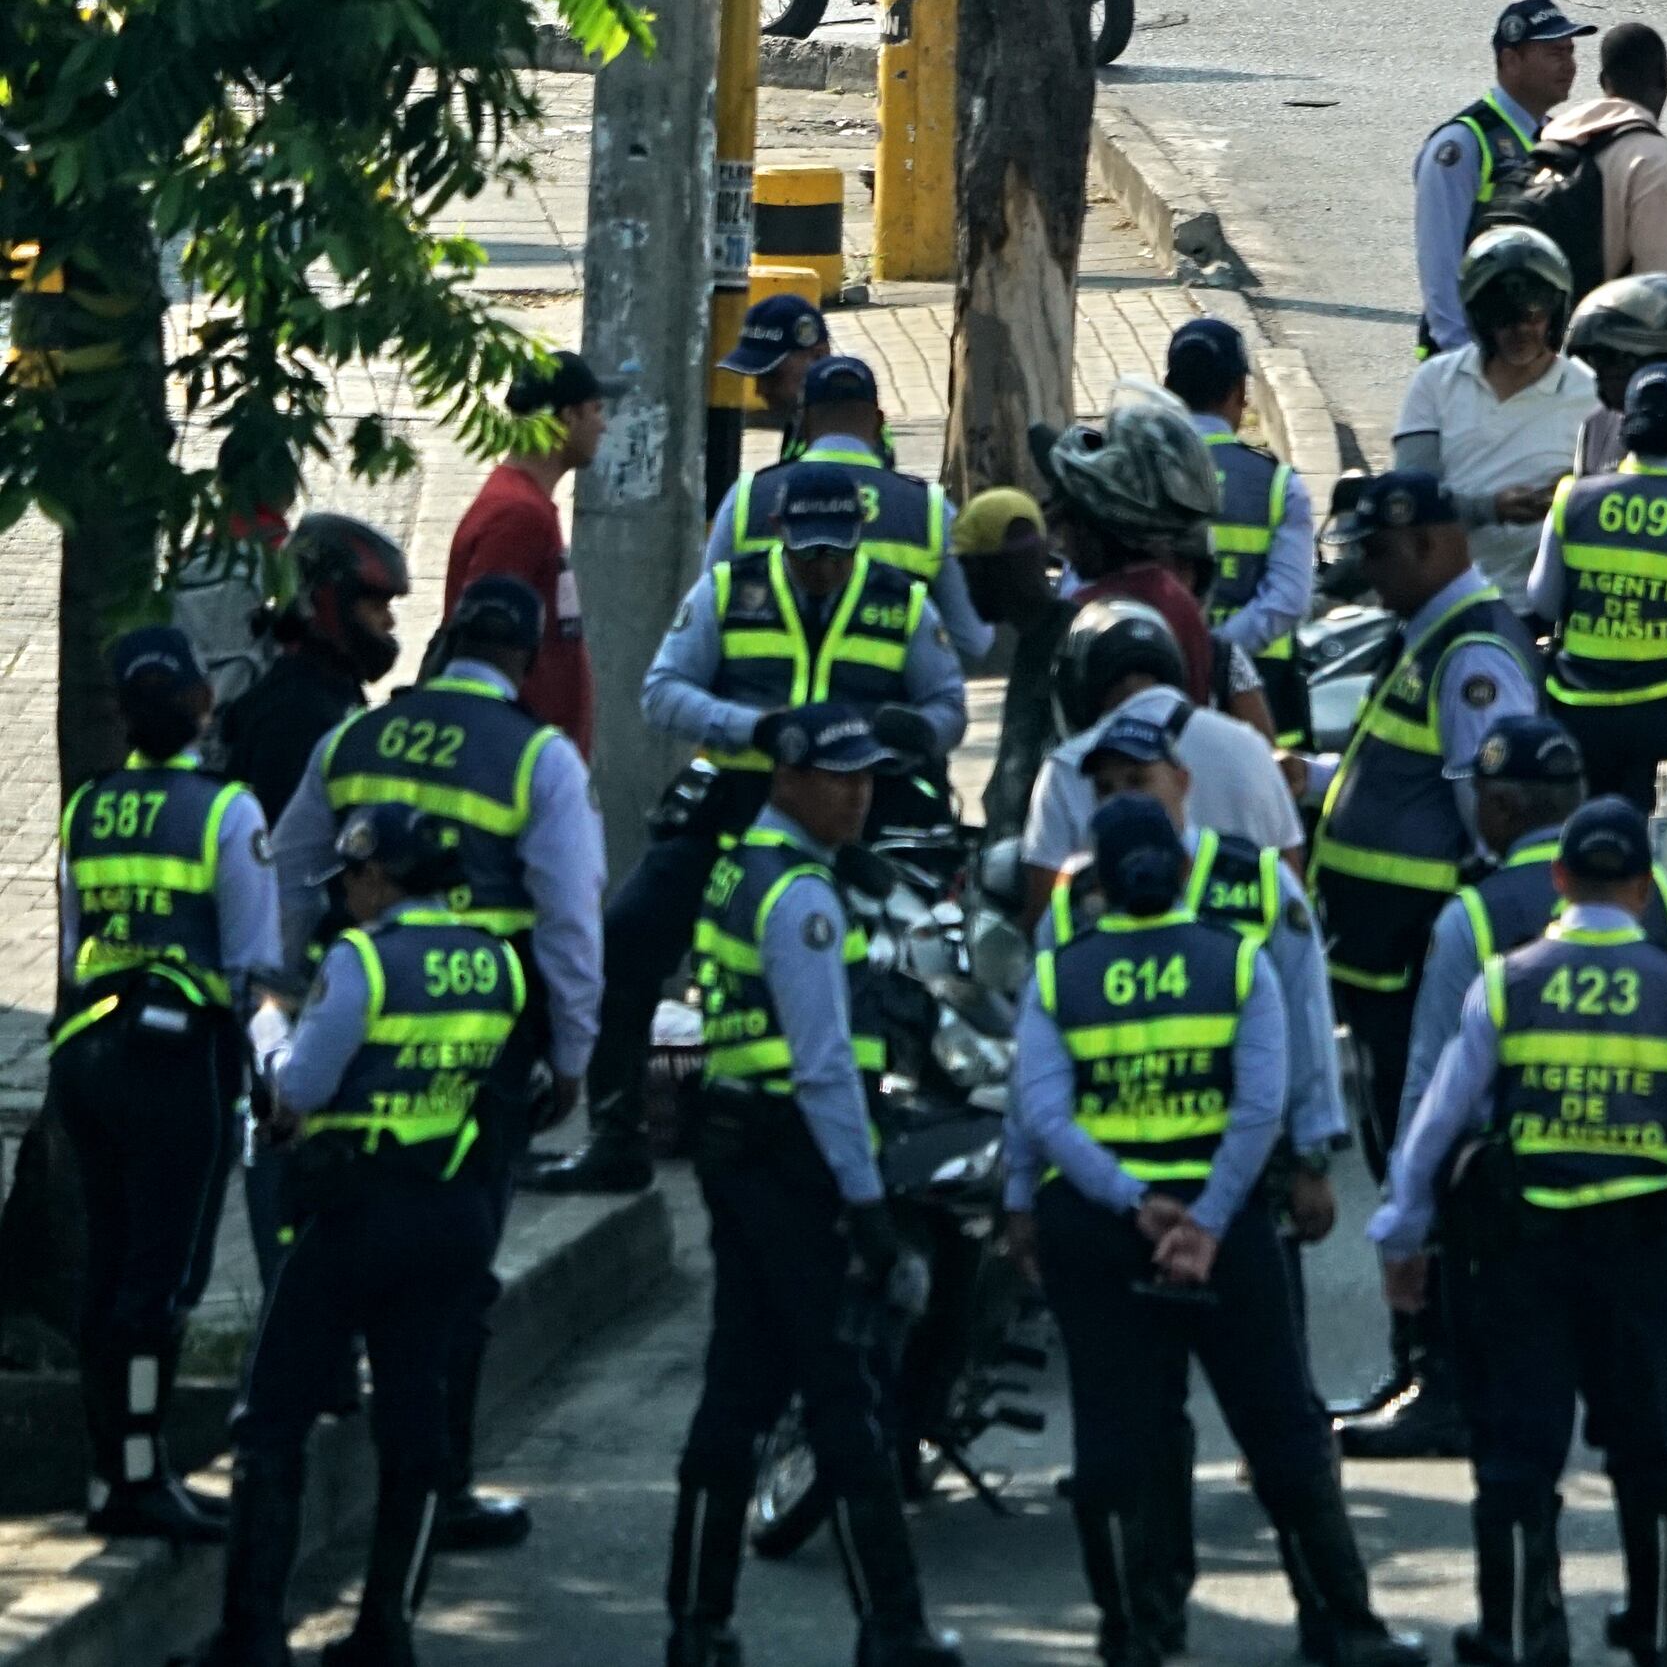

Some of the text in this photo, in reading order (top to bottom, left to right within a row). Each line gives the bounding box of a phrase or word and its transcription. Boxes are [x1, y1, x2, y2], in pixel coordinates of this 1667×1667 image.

[1604, 596, 1643, 622] DE
[377, 716, 467, 768] 622
[91, 790, 169, 839] 587
[423, 948, 499, 998] 569
[1103, 953, 1191, 1006] 614
[1540, 964, 1642, 1016] 423
[1521, 1064, 1654, 1098] AGENTE
[1560, 1093, 1609, 1123] DE
